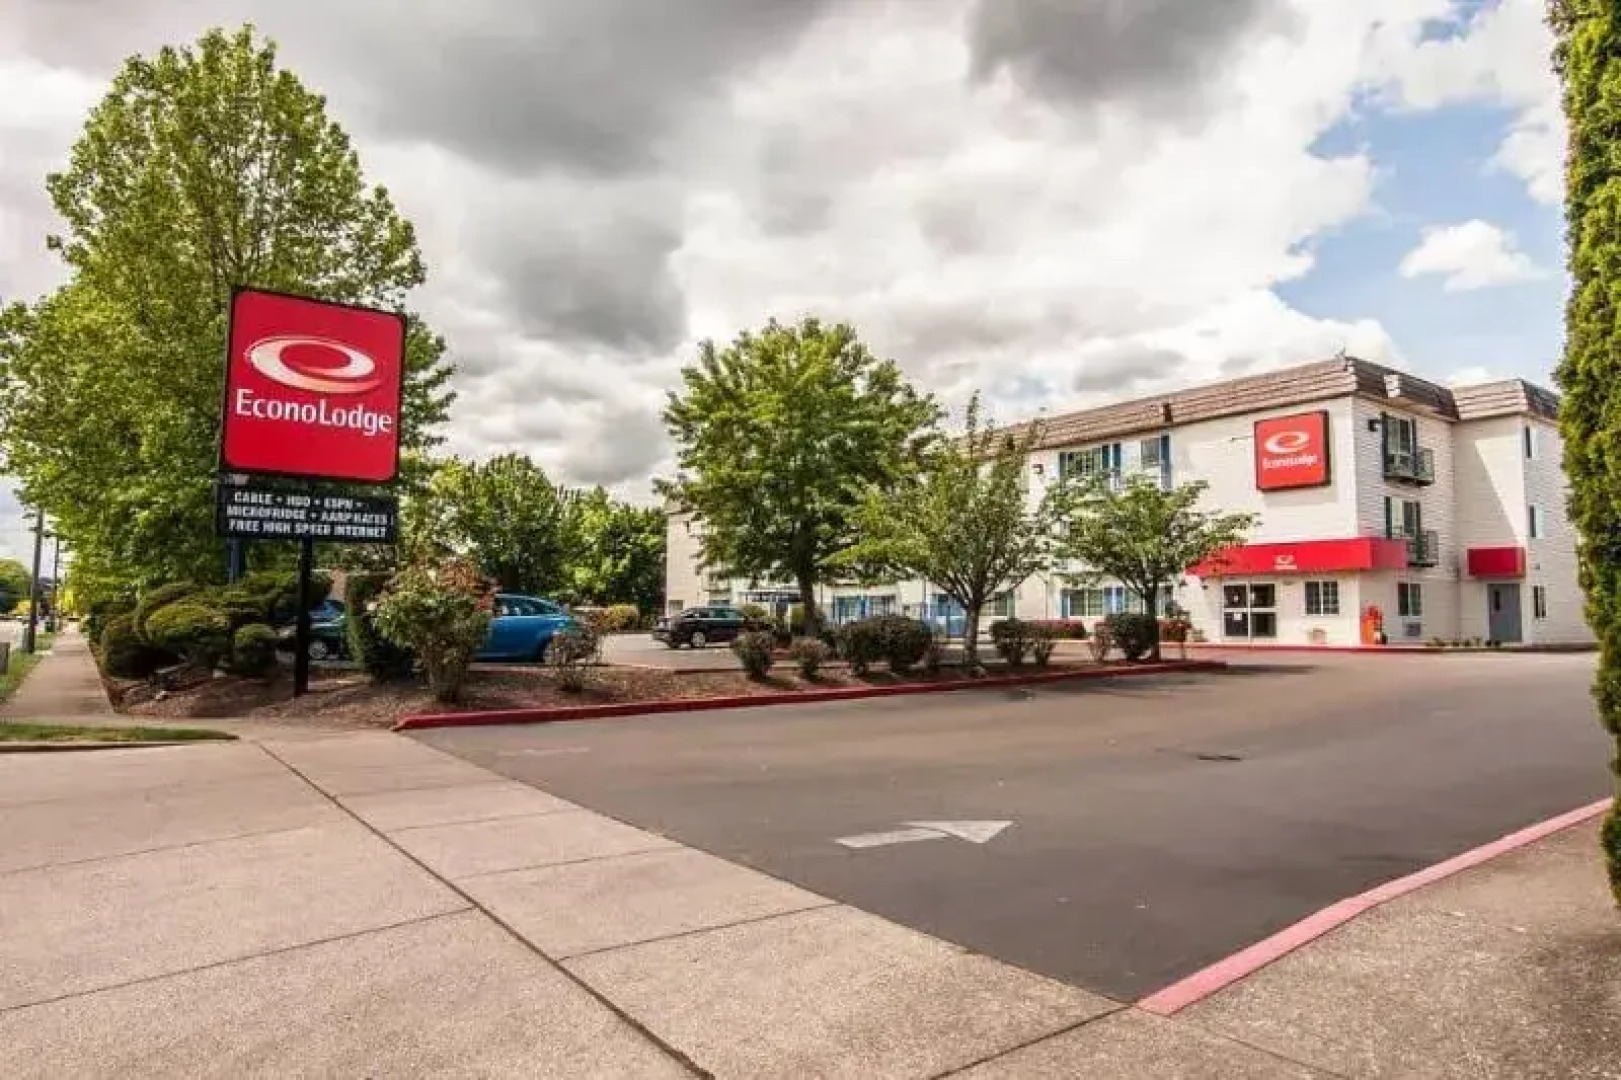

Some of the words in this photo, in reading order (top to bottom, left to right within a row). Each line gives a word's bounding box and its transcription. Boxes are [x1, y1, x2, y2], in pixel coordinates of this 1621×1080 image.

[236, 388, 392, 436] EconoLodge
[228, 519, 260, 532] FREE
[262, 521, 291, 534] HIGH
[294, 523, 331, 536] SPEED
[333, 525, 387, 538] INTERNET
